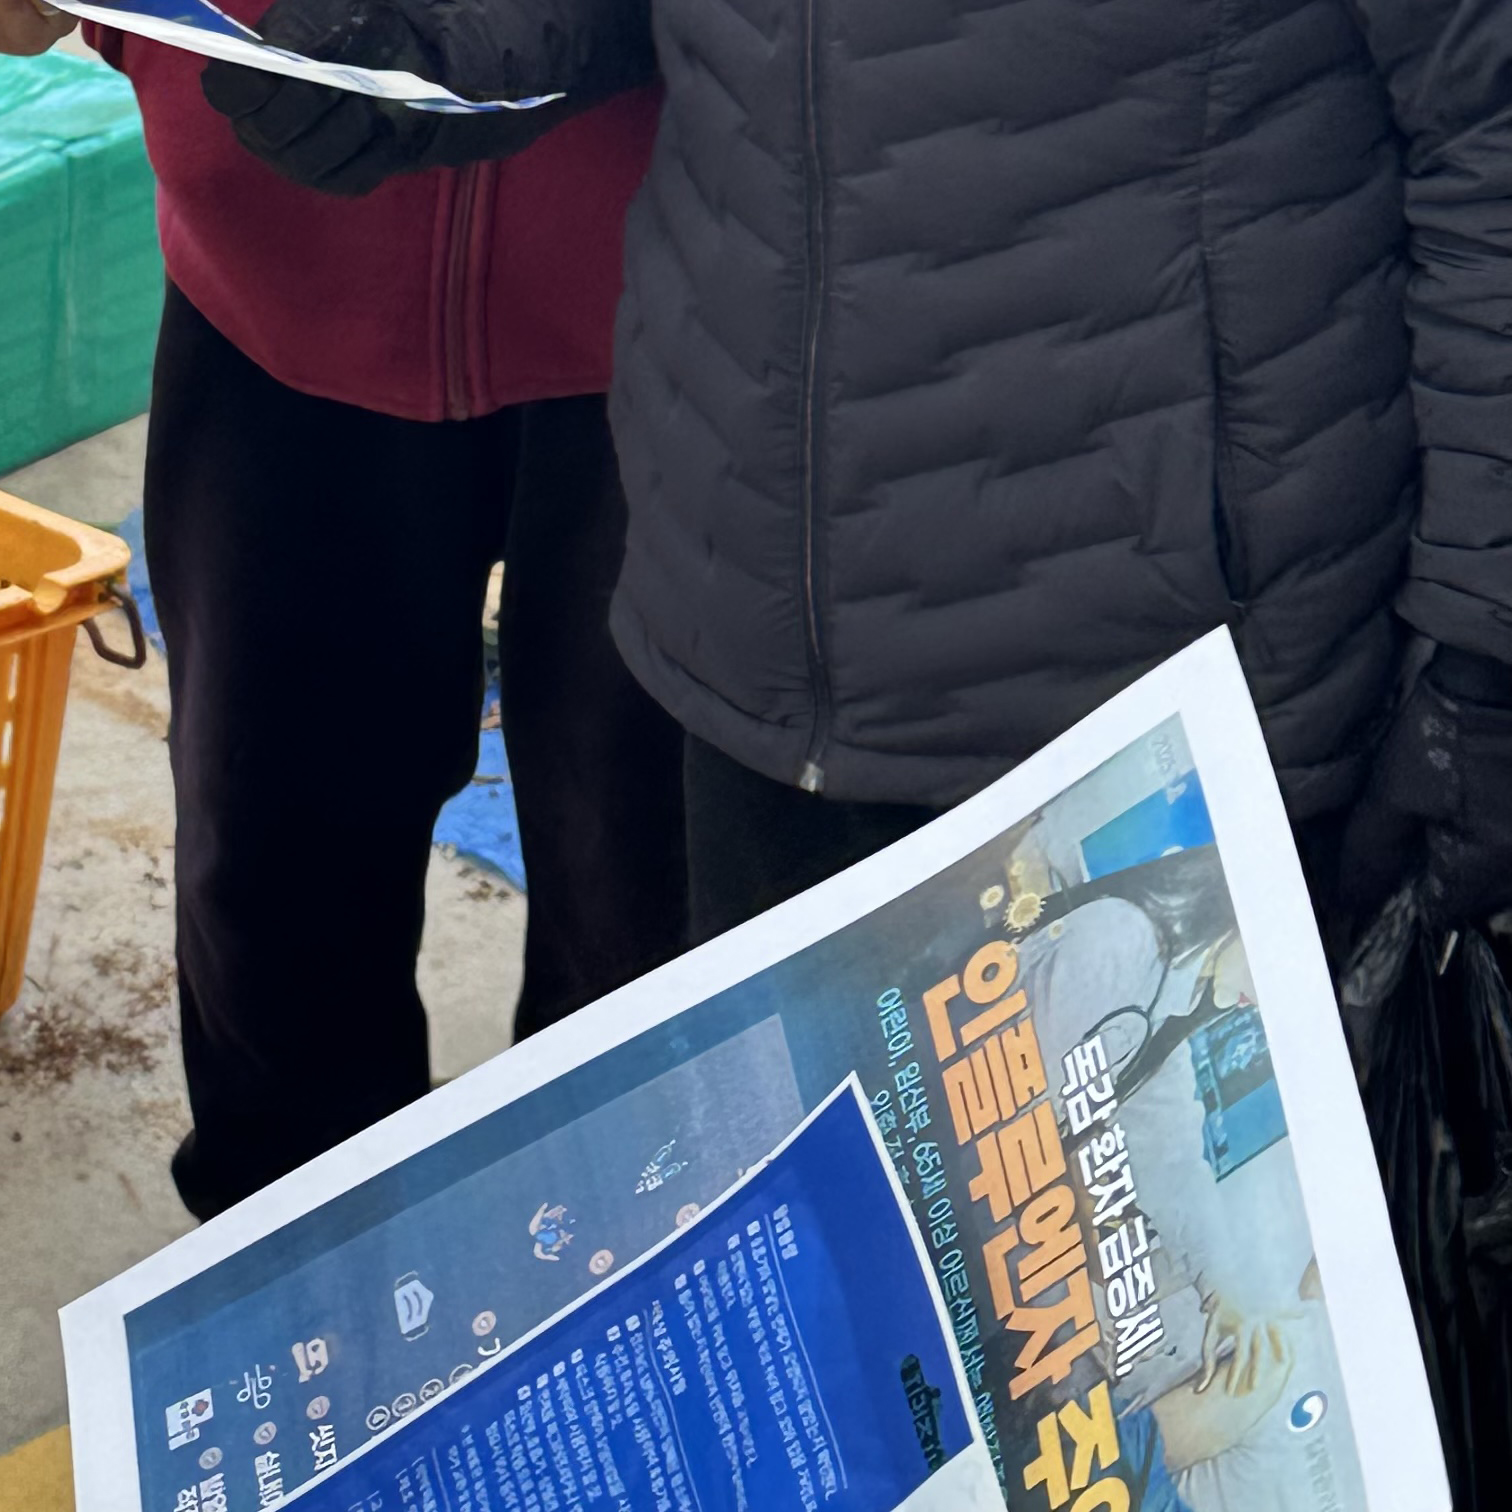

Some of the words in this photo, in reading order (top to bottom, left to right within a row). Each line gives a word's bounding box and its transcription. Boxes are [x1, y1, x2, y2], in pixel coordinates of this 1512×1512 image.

[877, 988, 914, 1067] 어린이,
[928, 1198, 958, 1248] 이상
[1063, 1036, 1116, 1134] 독감
[923, 940, 1100, 1400] 인플루엔자
[1079, 1125, 1136, 1225] 환자
[1099, 1216, 1162, 1375] 급증세,
